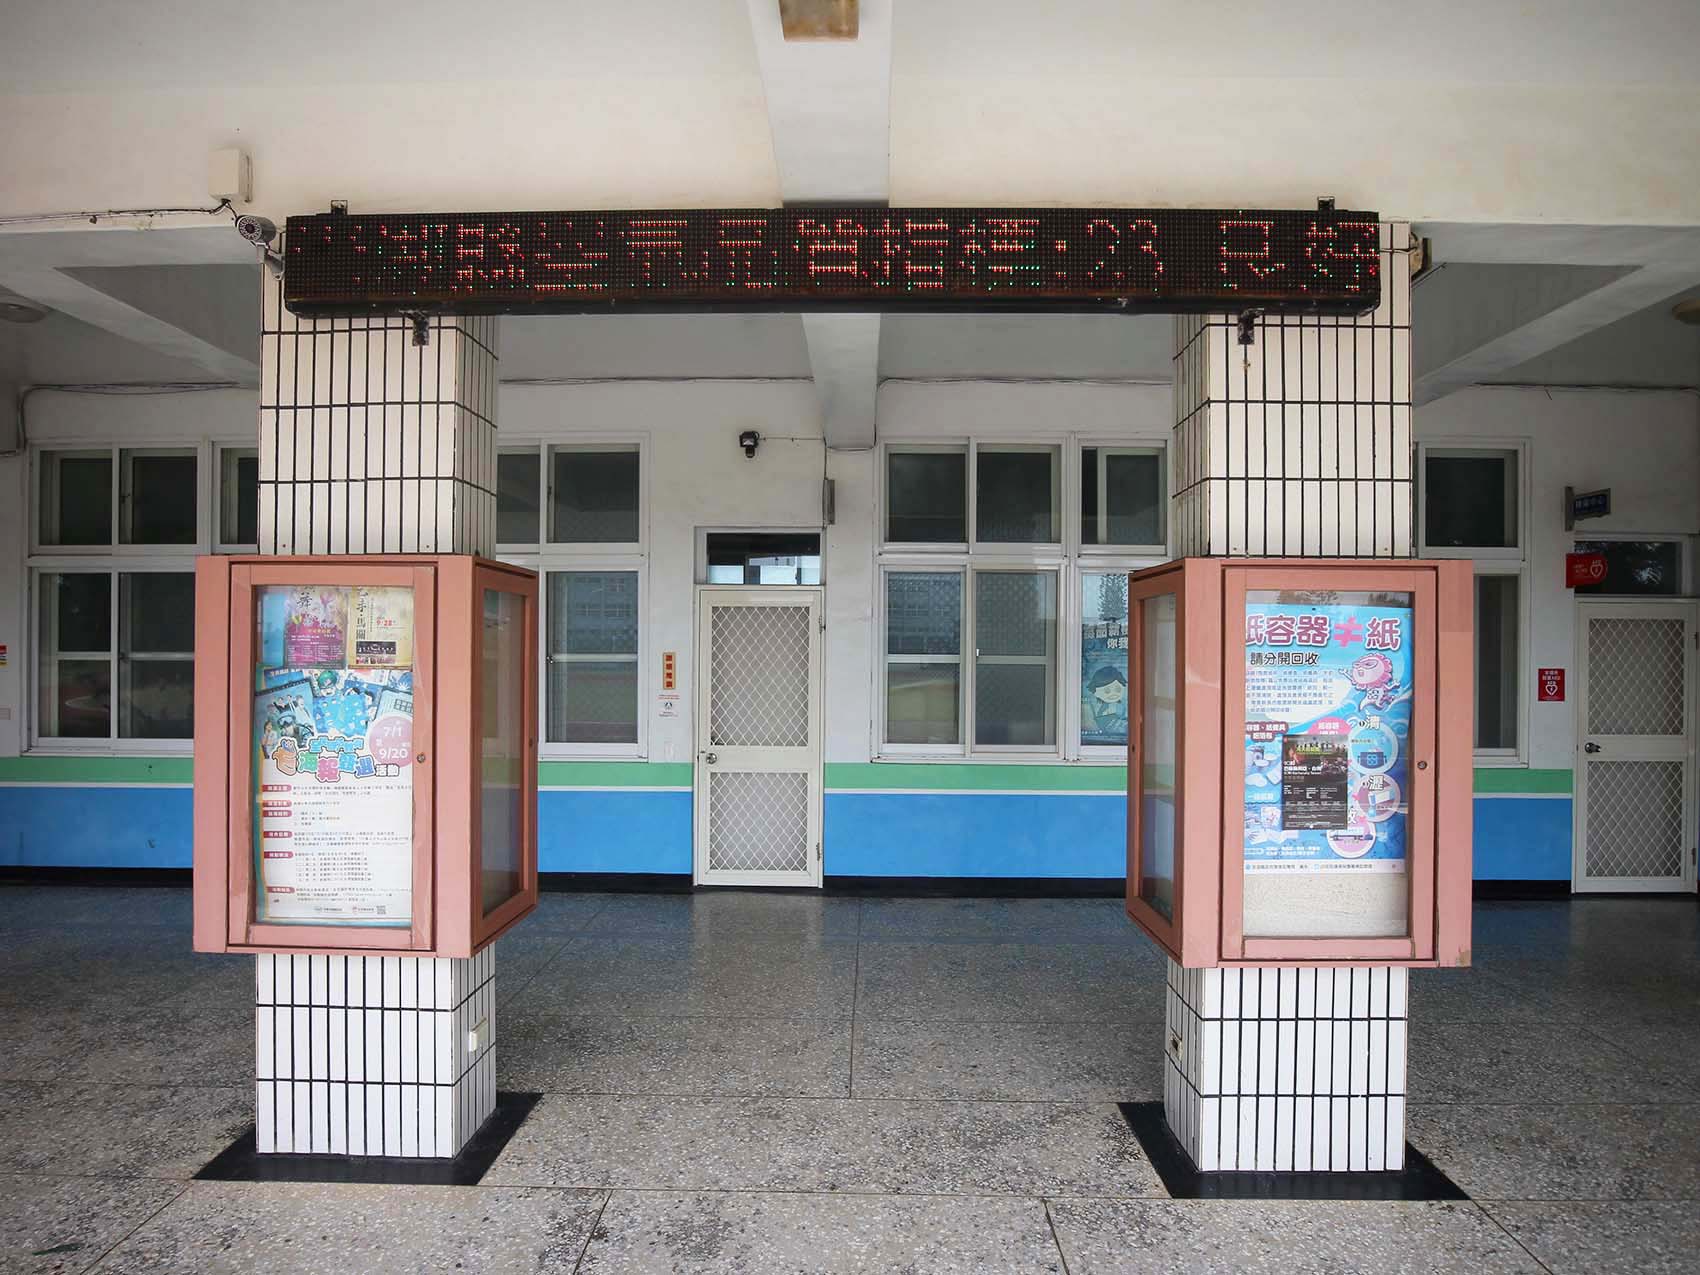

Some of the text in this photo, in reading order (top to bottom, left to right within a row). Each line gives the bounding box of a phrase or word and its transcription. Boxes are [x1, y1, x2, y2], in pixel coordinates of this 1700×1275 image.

[1250, 651, 1320, 667] 請分開回收
[383, 726, 403, 737] 7/1
[378, 747, 408, 760] 9/20
